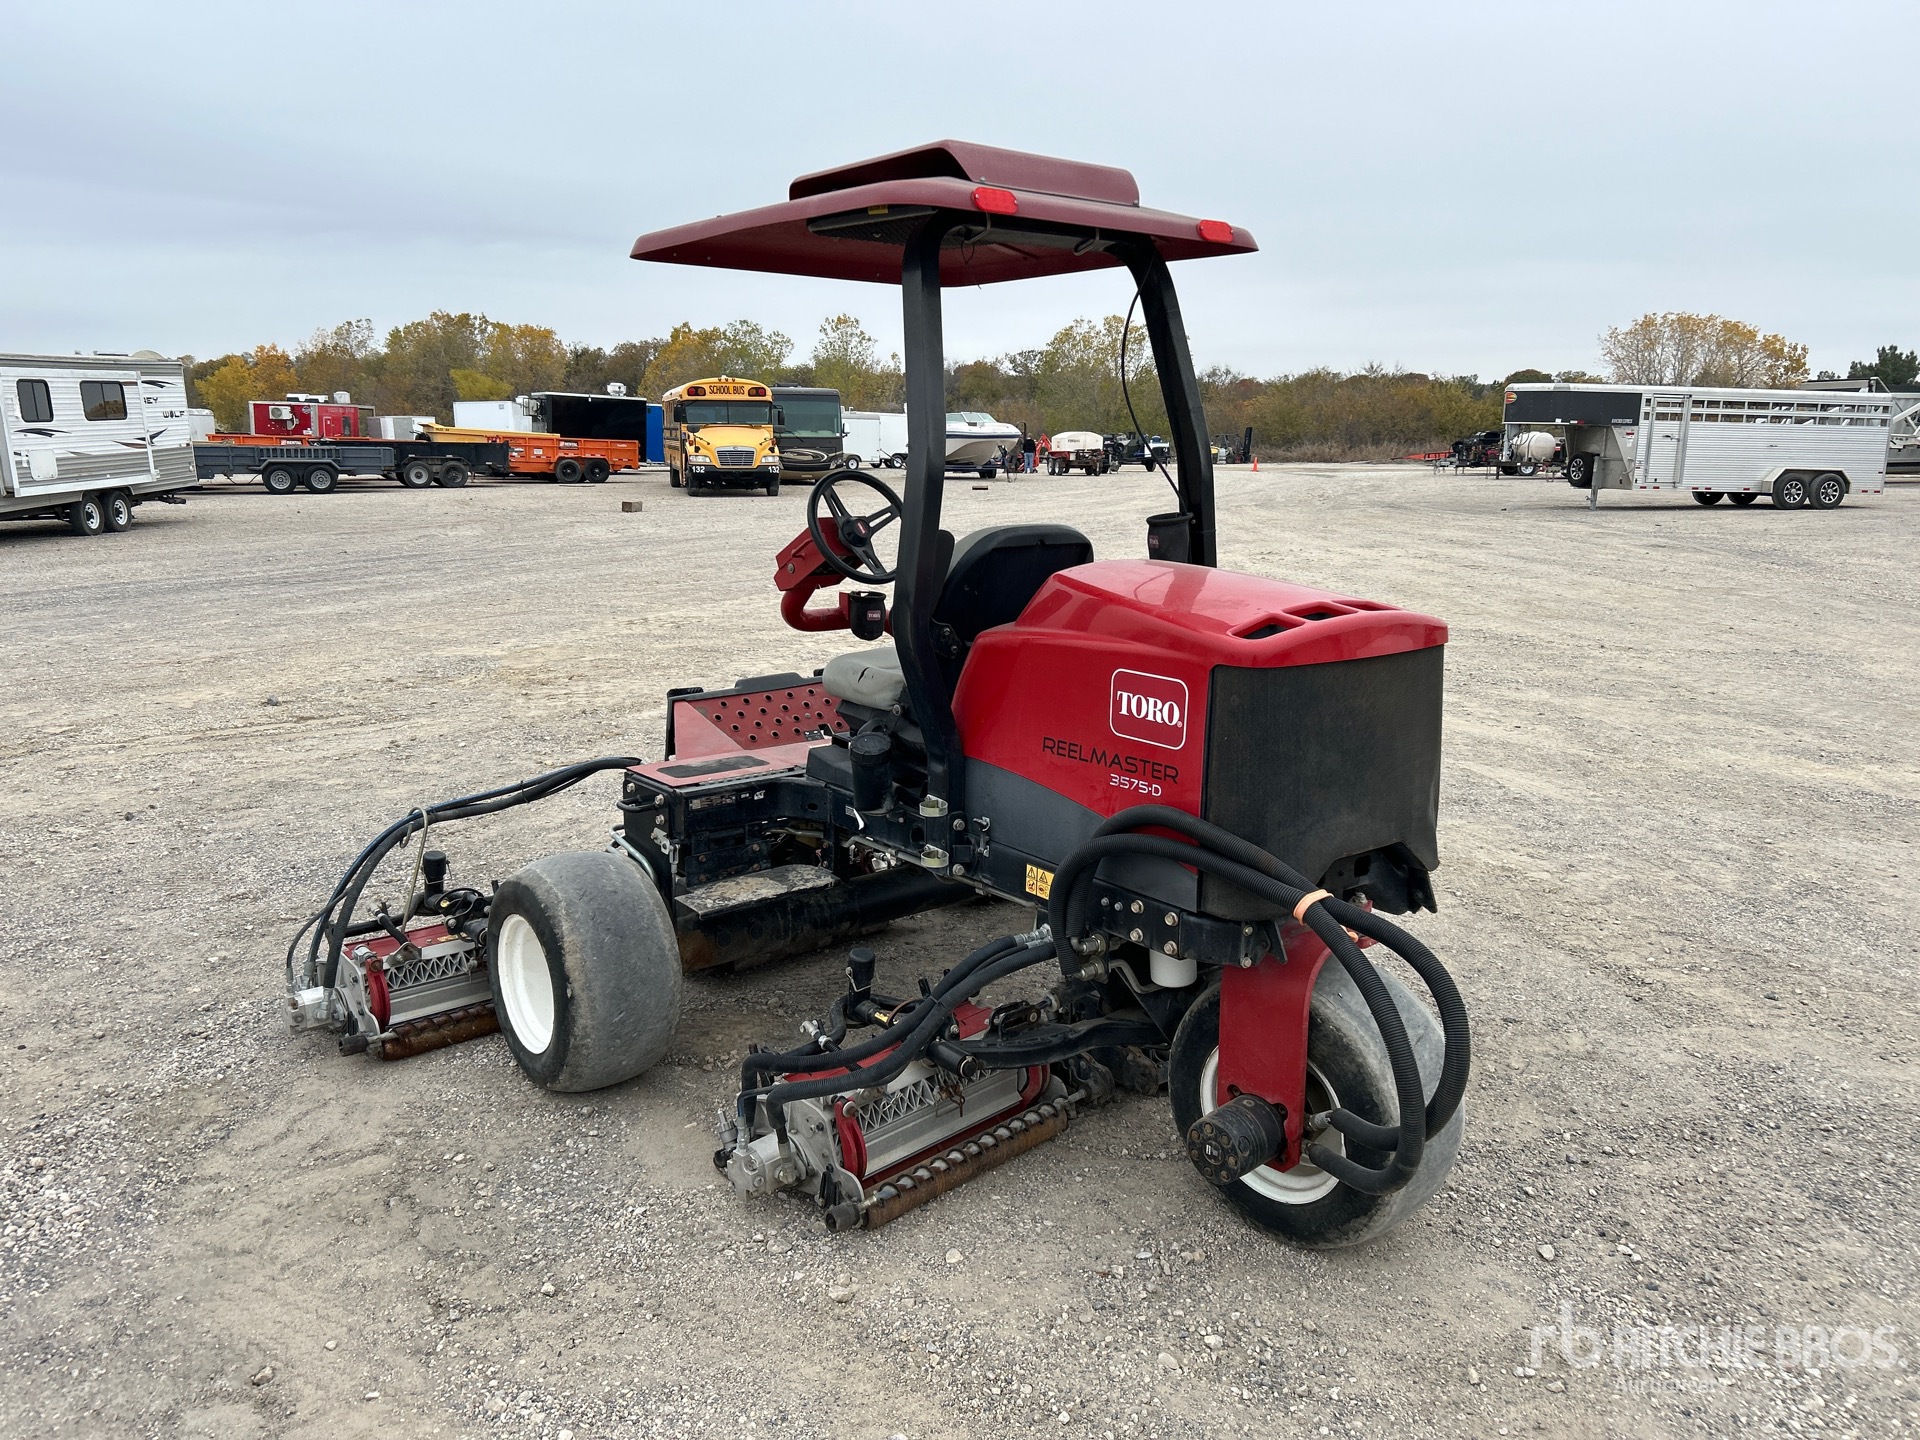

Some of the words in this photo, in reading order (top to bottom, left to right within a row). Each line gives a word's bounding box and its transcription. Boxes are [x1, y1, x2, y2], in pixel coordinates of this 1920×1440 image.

[709, 385, 732, 395] SCHOOL
[733, 385, 745, 395] BUS
[162, 410, 185, 418] WOLF
[1042, 736, 1179, 784] REELMASTER
